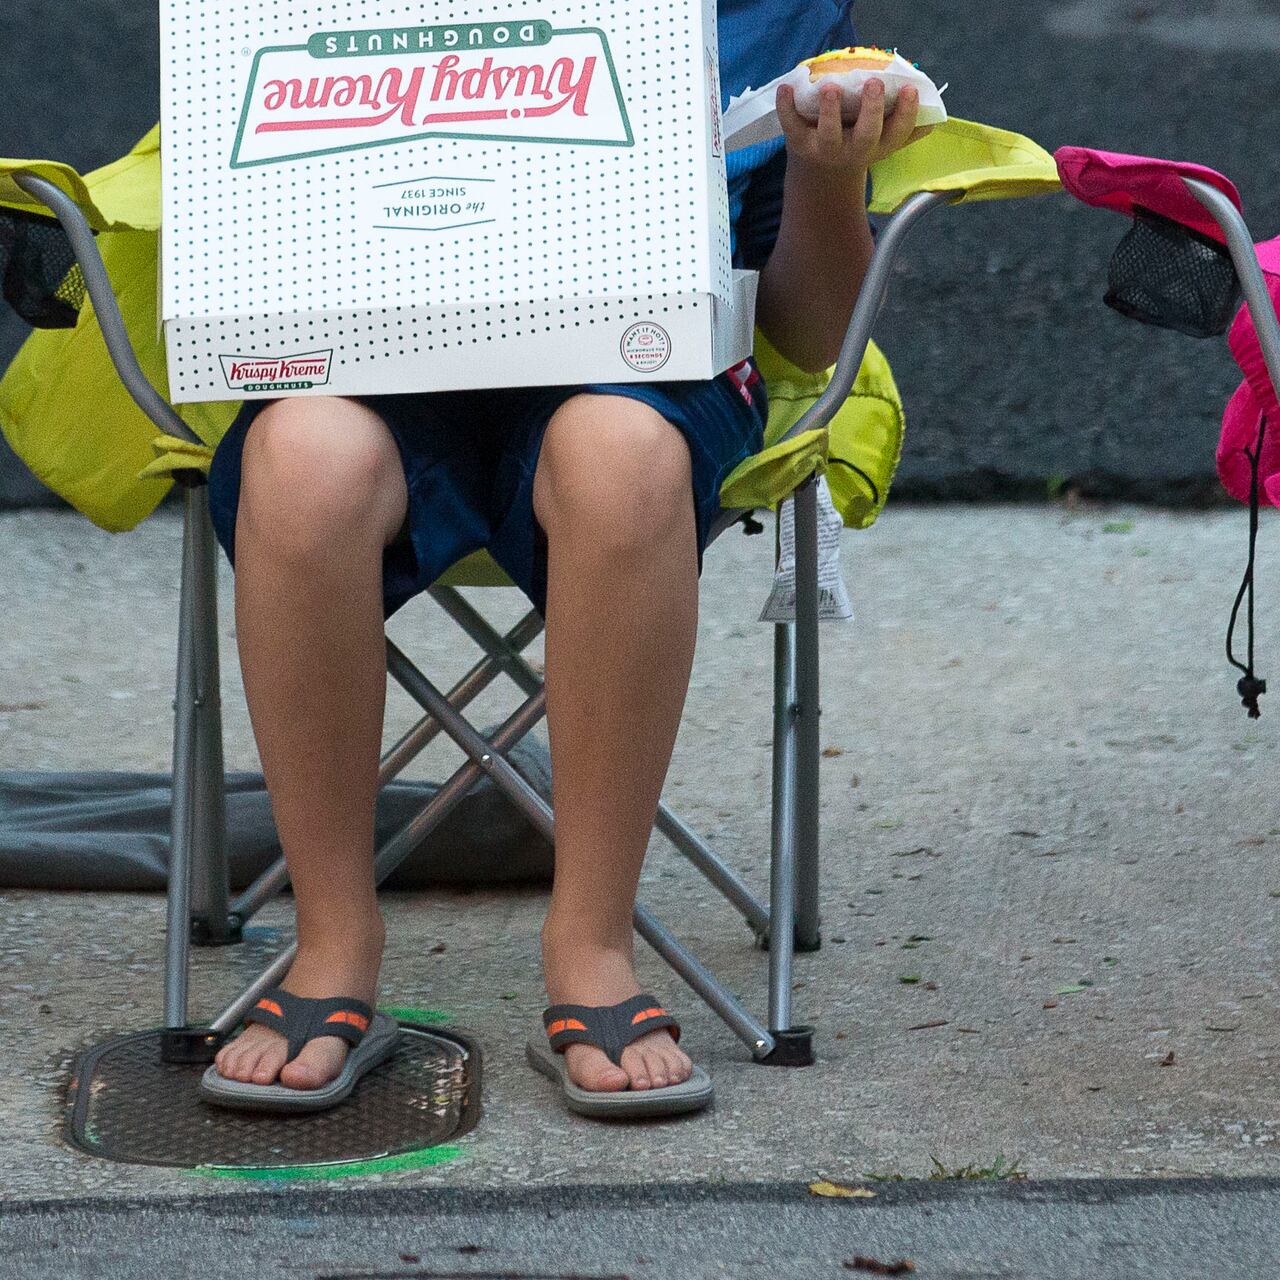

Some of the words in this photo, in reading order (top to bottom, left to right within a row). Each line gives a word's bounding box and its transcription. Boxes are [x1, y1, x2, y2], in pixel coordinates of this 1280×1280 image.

[325, 24, 534, 54] DOUGHNUTS
[422, 55, 597, 126] Krispy
[255, 66, 425, 135] Kreme
[401, 189, 426, 199] 1937
[429, 187, 467, 198] SINCE
[383, 203, 461, 218] ORIGINAL
[466, 202, 485, 213] the
[230, 360, 279, 381] Krispy
[279, 358, 327, 379] Kreme
[247, 382, 309, 391] DOUGHNUTS
